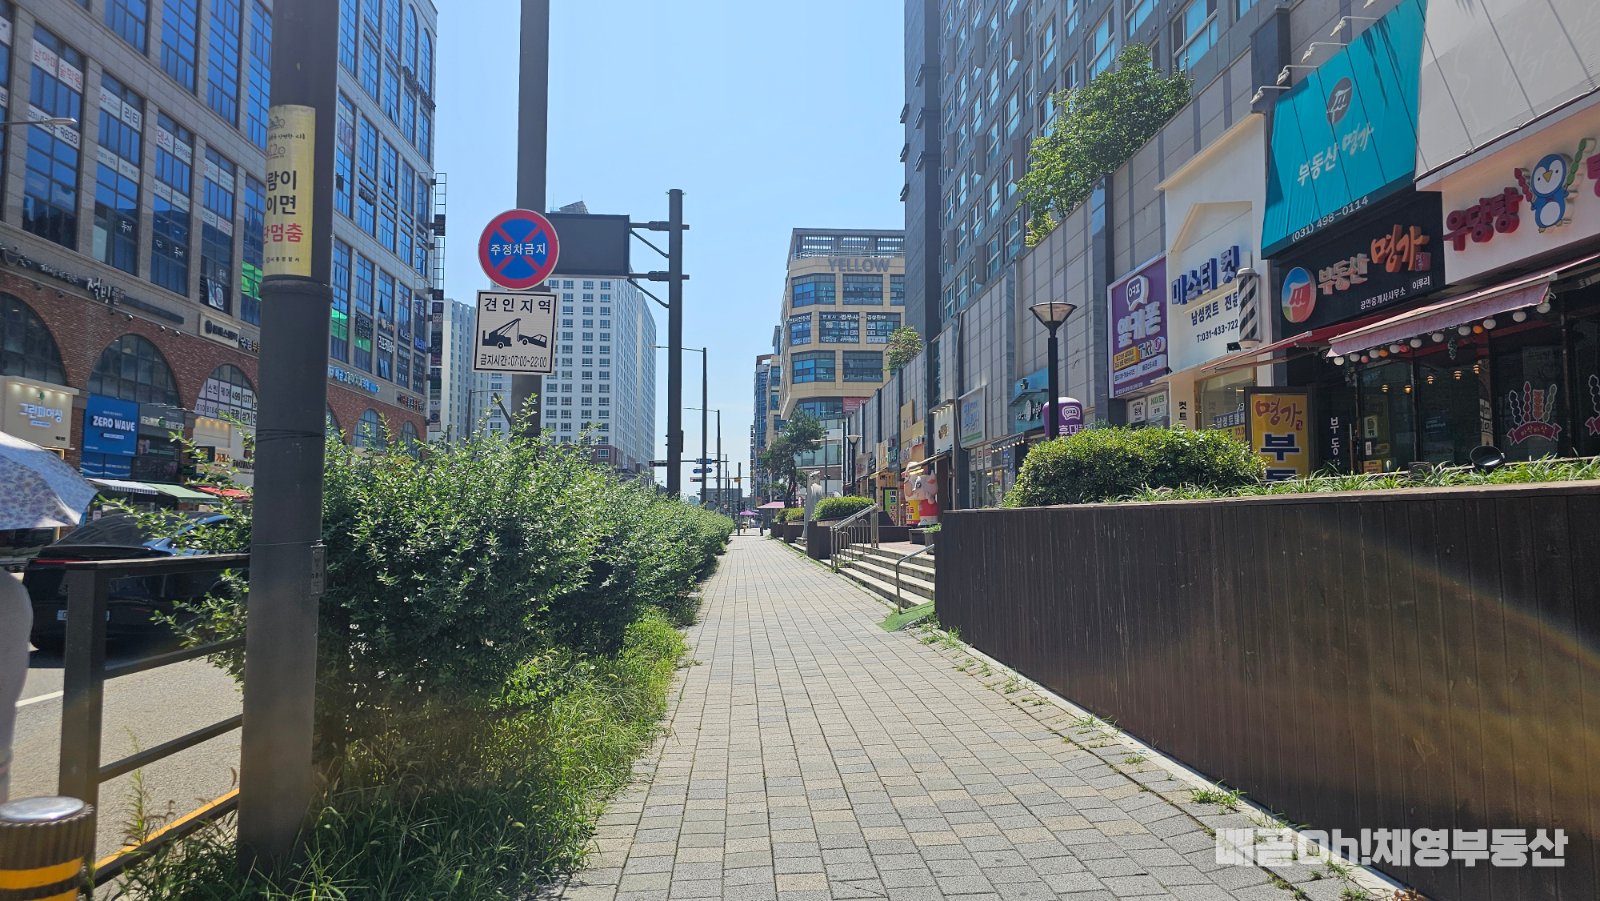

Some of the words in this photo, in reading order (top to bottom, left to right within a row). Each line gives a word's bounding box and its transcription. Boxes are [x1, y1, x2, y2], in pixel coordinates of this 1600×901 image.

[1297, 142, 1339, 187] 부동산
[1342, 121, 1374, 156] 명가
[266, 195, 296, 215] 이면
[1291, 223, 1314, 243] (031)
[1316, 196, 1369, 228] 498-0114
[1442, 186, 1524, 252] 우당탕
[490, 242, 547, 256] 주정차금지
[828, 258, 892, 272] YELLOW
[1318, 253, 1369, 296] 부동산
[1370, 224, 1430, 273] 명가
[484, 297, 551, 314] 견인지역
[480, 353, 547, 369] 금지시간:07:00~22:00
[1255, 398, 1302, 426] 명가
[93, 414, 114, 428] ZERO
[114, 418, 136, 432] WAVE
